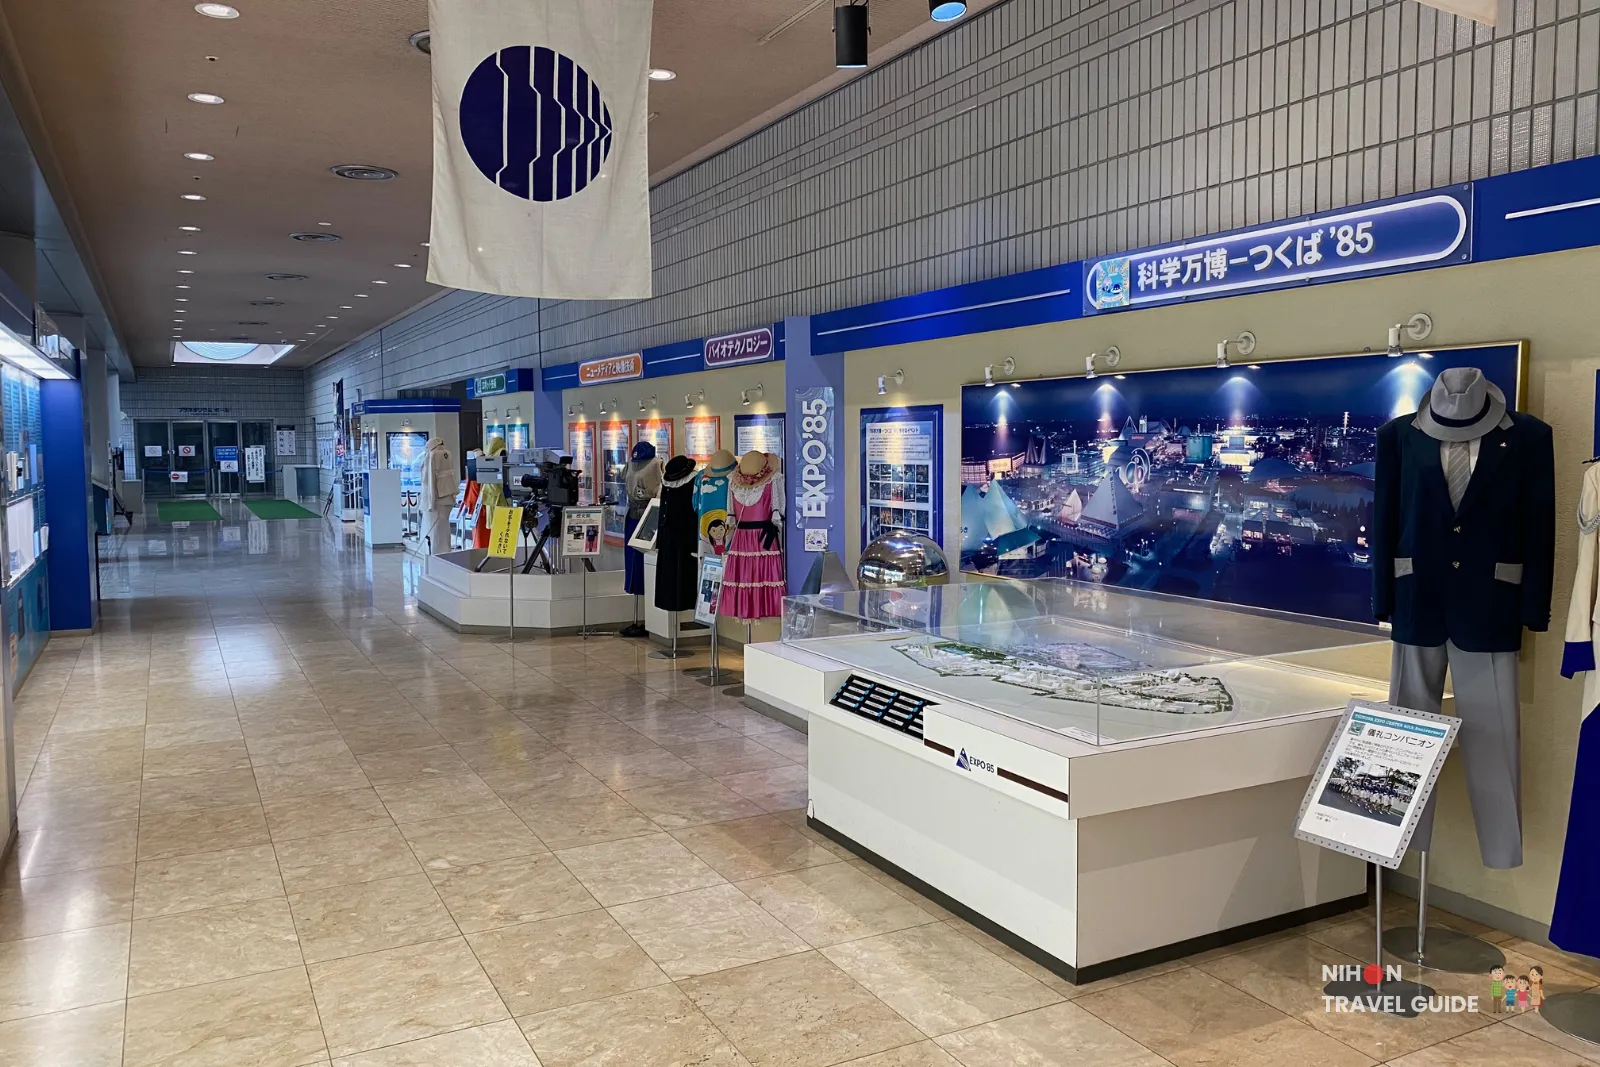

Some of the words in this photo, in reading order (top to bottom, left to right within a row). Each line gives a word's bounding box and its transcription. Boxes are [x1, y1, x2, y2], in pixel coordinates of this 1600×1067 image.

[708, 335, 768, 359] バイオテクノロジー
[496, 531, 504, 554] ください
[970, 757, 985, 769] EXPO
